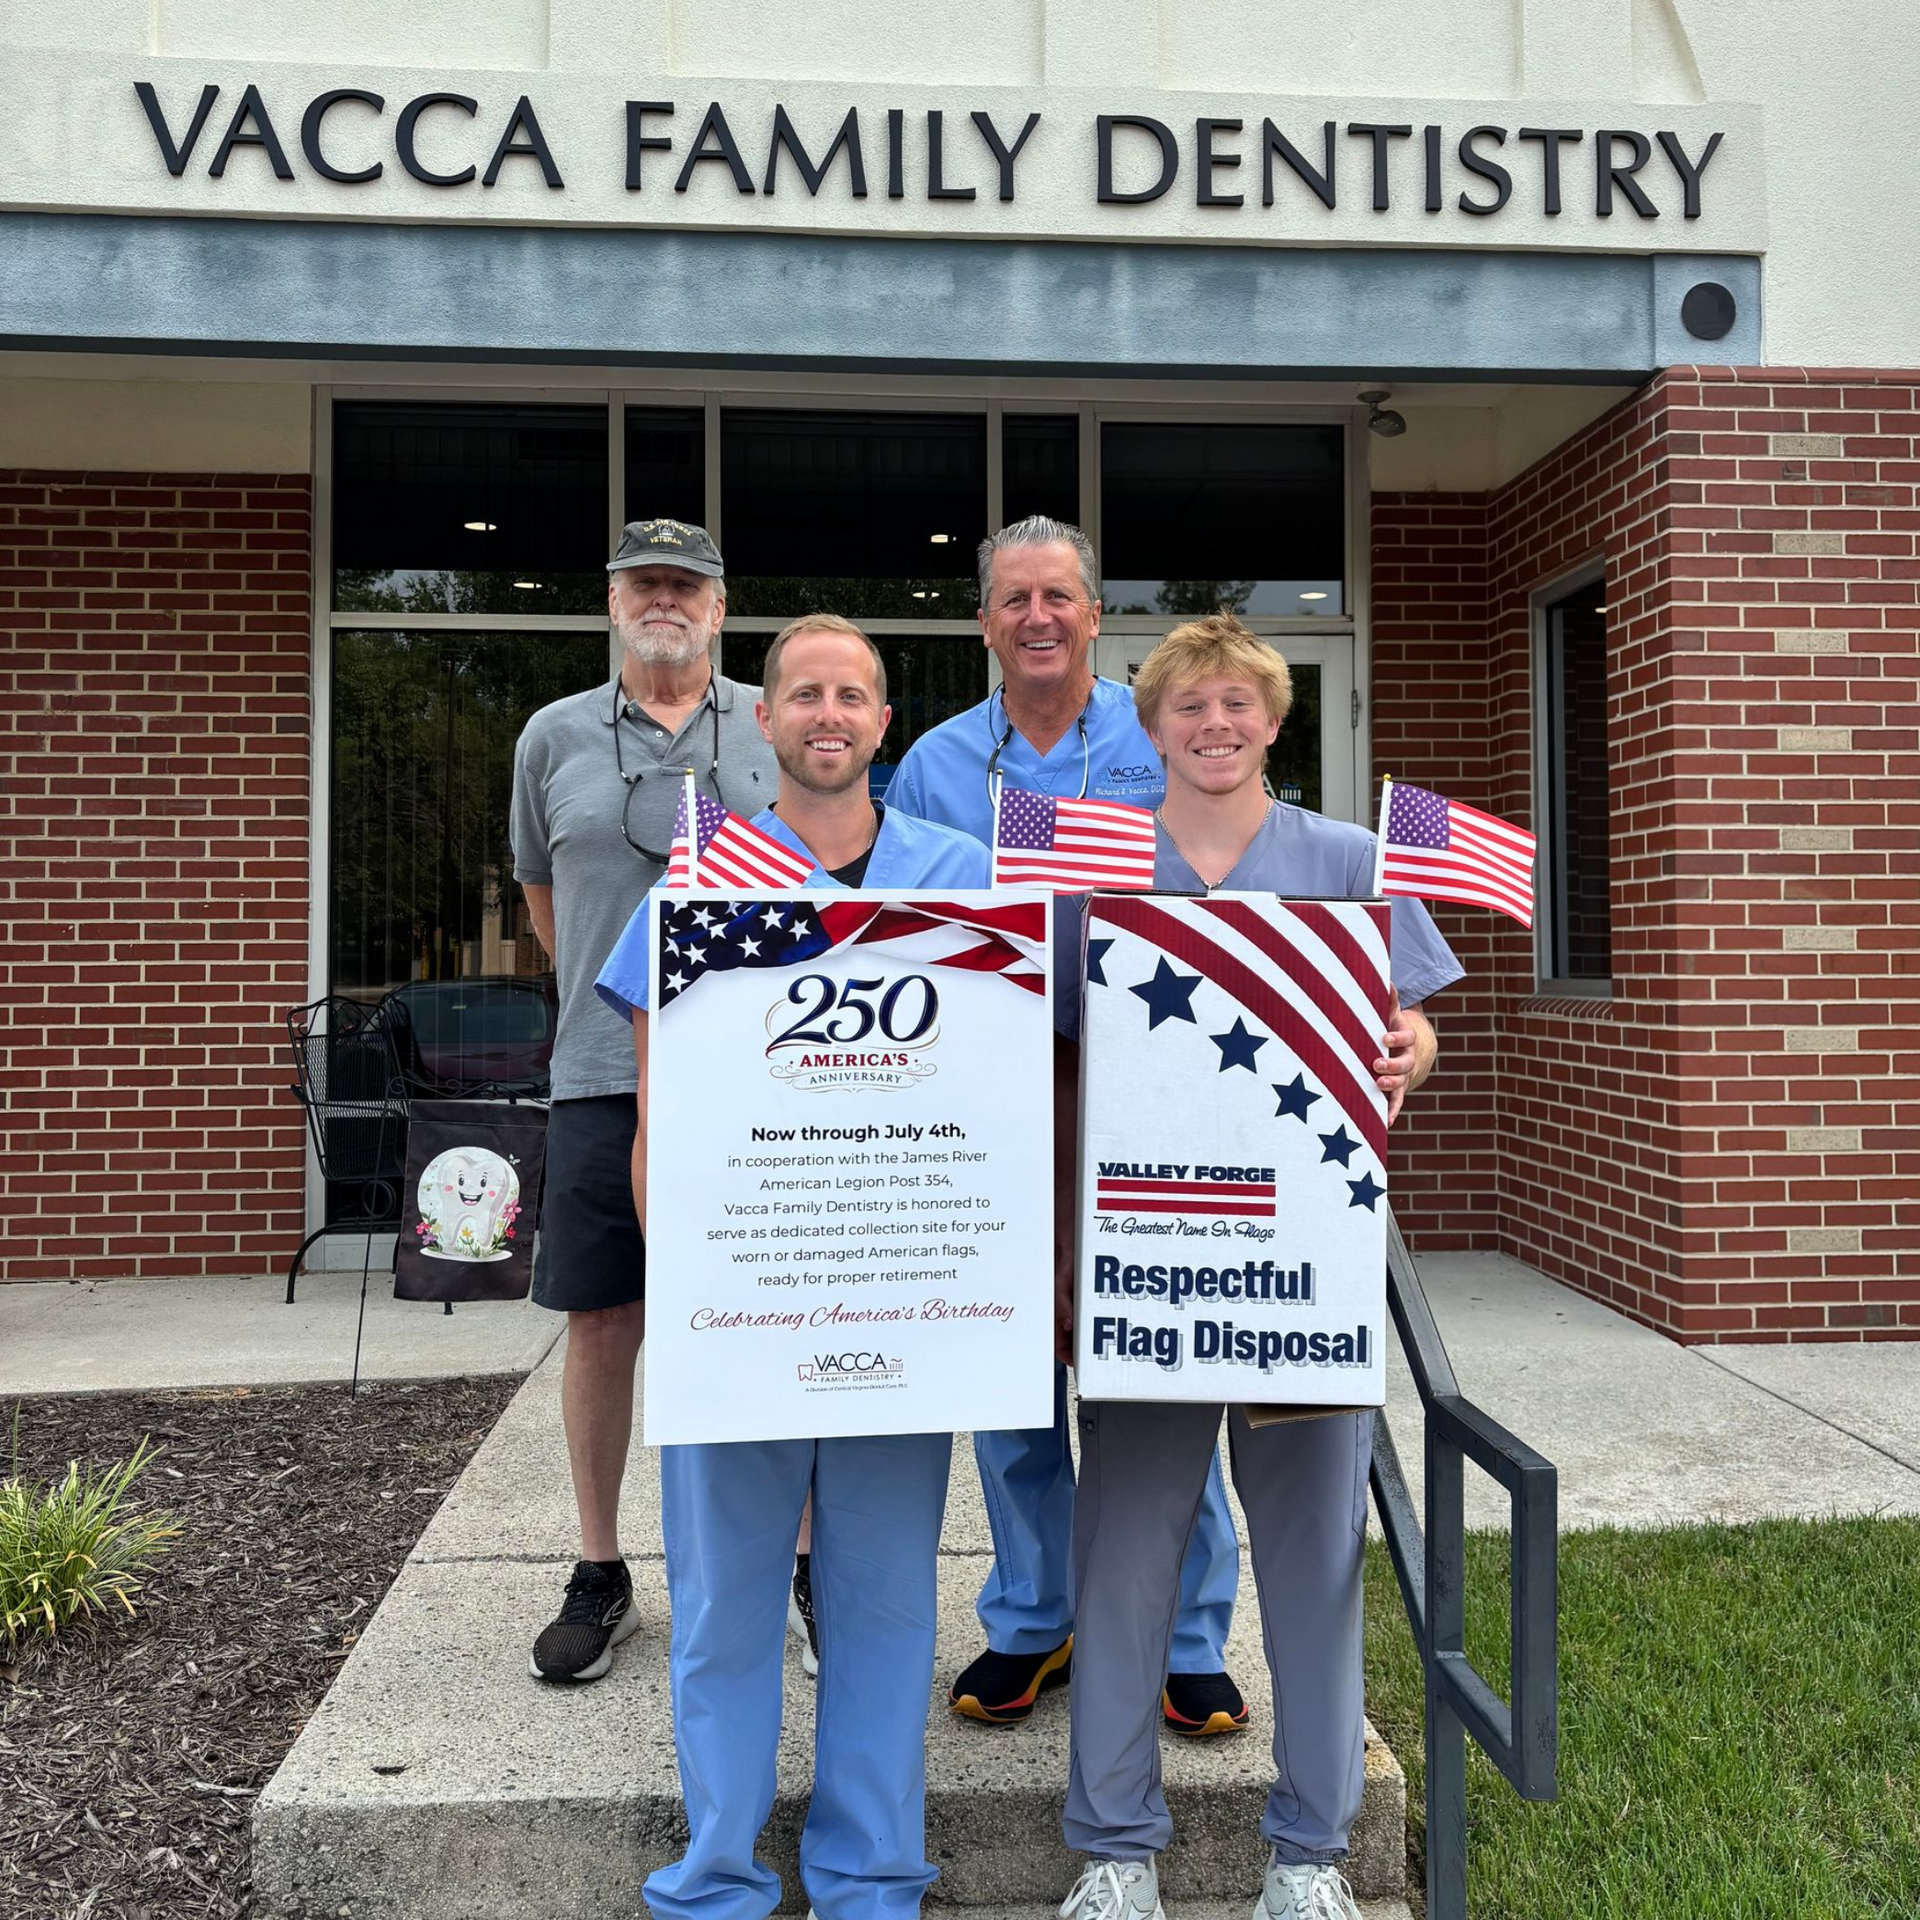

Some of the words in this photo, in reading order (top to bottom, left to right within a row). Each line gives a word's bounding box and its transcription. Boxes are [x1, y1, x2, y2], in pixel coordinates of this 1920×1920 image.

[133, 82, 565, 189] VACCA
[625, 101, 1041, 201] FAMILY
[1096, 114, 1725, 219] DENTISTRY
[650, 536, 683, 546] VETERAN
[1107, 765, 1152, 778] VACCA
[767, 974, 939, 1048] 250
[800, 1053, 909, 1068] AMERICA'S
[809, 1071, 903, 1085] ANNIVERSARY
[751, 1127, 796, 1142] Now
[801, 1125, 880, 1144] through
[884, 1124, 924, 1143] July
[928, 1123, 966, 1140] 4th,
[727, 1156, 742, 1168] in
[745, 1154, 835, 1170] cooperation
[838, 1152, 870, 1165] with
[874, 1151, 899, 1164] the
[901, 1151, 949, 1164] James
[952, 1150, 988, 1163] River
[759, 1178, 831, 1191] American
[836, 1176, 885, 1191] Legion
[889, 1175, 921, 1188] Post
[924, 1174, 953, 1189] 354,
[1098, 1162, 1189, 1180] VALLEY
[1195, 1165, 1276, 1183] FORGE
[724, 1203, 769, 1216] Vacca
[773, 1201, 822, 1217] Family
[826, 1199, 893, 1215] Dentistry
[897, 1198, 908, 1211] is
[911, 1197, 972, 1210] honored
[976, 1197, 991, 1209] to
[707, 1229, 747, 1240] serve
[750, 1229, 767, 1239] as
[770, 1224, 845, 1239] dedicated
[848, 1222, 918, 1236] collection
[922, 1221, 948, 1234] site
[951, 1220, 970, 1233] for
[973, 1220, 1006, 1235] your
[1093, 1216, 1119, 1234] The
[1121, 1217, 1174, 1237] Greatest
[1176, 1218, 1208, 1237] Name
[1210, 1220, 1232, 1238] In
[1234, 1221, 1276, 1243] Flags
[732, 1252, 770, 1264] worn
[774, 1252, 790, 1262] or
[793, 1247, 864, 1263] damaged
[868, 1245, 938, 1259] American
[942, 1243, 979, 1259] flags,
[758, 1272, 800, 1288] ready
[803, 1271, 823, 1285] for
[827, 1271, 876, 1287] proper
[880, 1268, 958, 1282] retirement
[1094, 1255, 1314, 1307] Respectful
[690, 1308, 805, 1331] Celebrating
[809, 1302, 917, 1328] America's
[920, 1298, 1015, 1322] Birthday
[1093, 1316, 1182, 1369] Flag
[1194, 1320, 1370, 1372] Disposal
[814, 1352, 888, 1372] VACCA
[852, 1374, 894, 1382] DENTISTRY
